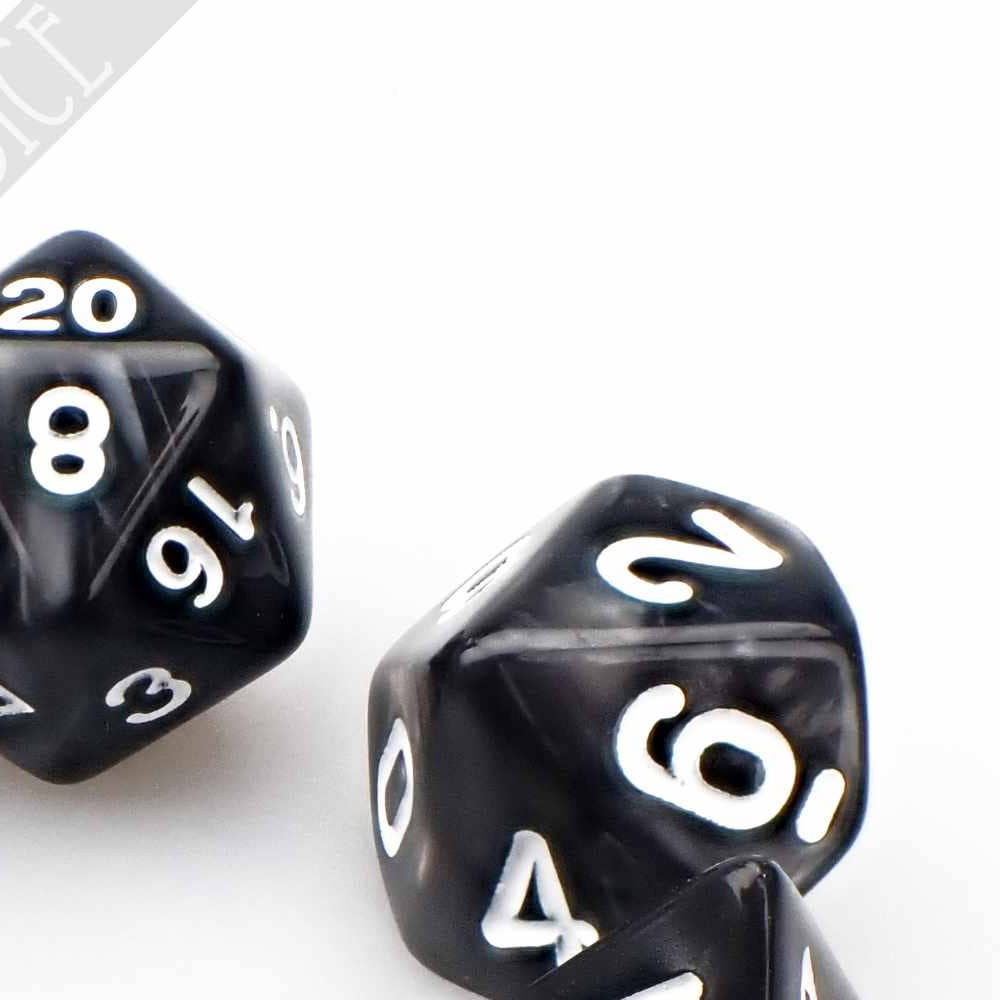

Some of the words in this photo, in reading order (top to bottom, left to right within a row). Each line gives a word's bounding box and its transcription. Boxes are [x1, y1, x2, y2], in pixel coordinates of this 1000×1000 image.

[28, 386, 110, 496] 8
[146, 477, 255, 608] 16
[596, 508, 784, 604] 2
[105, 667, 192, 723] 3
[377, 718, 414, 858] 0
[481, 830, 600, 967] 4
